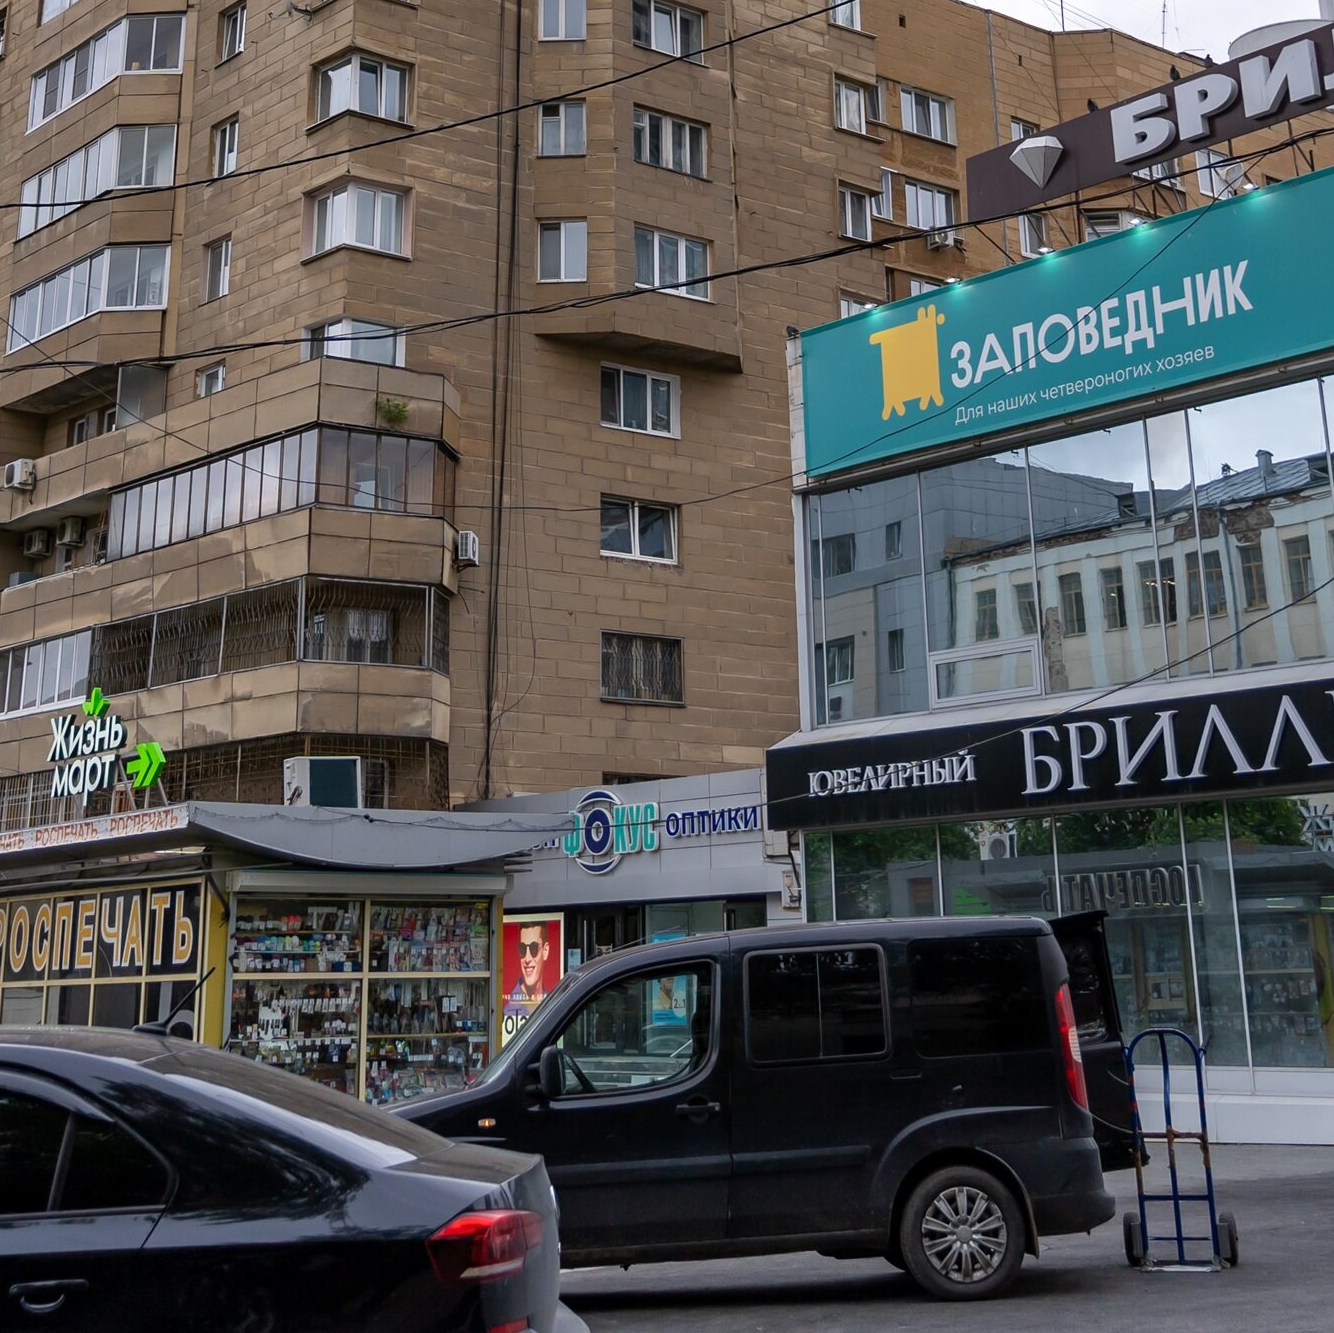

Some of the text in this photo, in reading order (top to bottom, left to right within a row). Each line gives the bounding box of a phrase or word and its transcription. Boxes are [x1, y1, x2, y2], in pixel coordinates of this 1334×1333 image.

[950, 259, 1254, 389] ЗАПОВЕДНИК
[955, 343, 1216, 426] Для наших четвероногих хозяев
[807, 749, 978, 797] ЮВЕЛИРНЫЙ
[36, 822, 98, 847] РОСПЕЧАТЬ
[109, 810, 180, 835] РОСПЕЧАТЬ
[666, 805, 762, 838] ОПТИКИ
